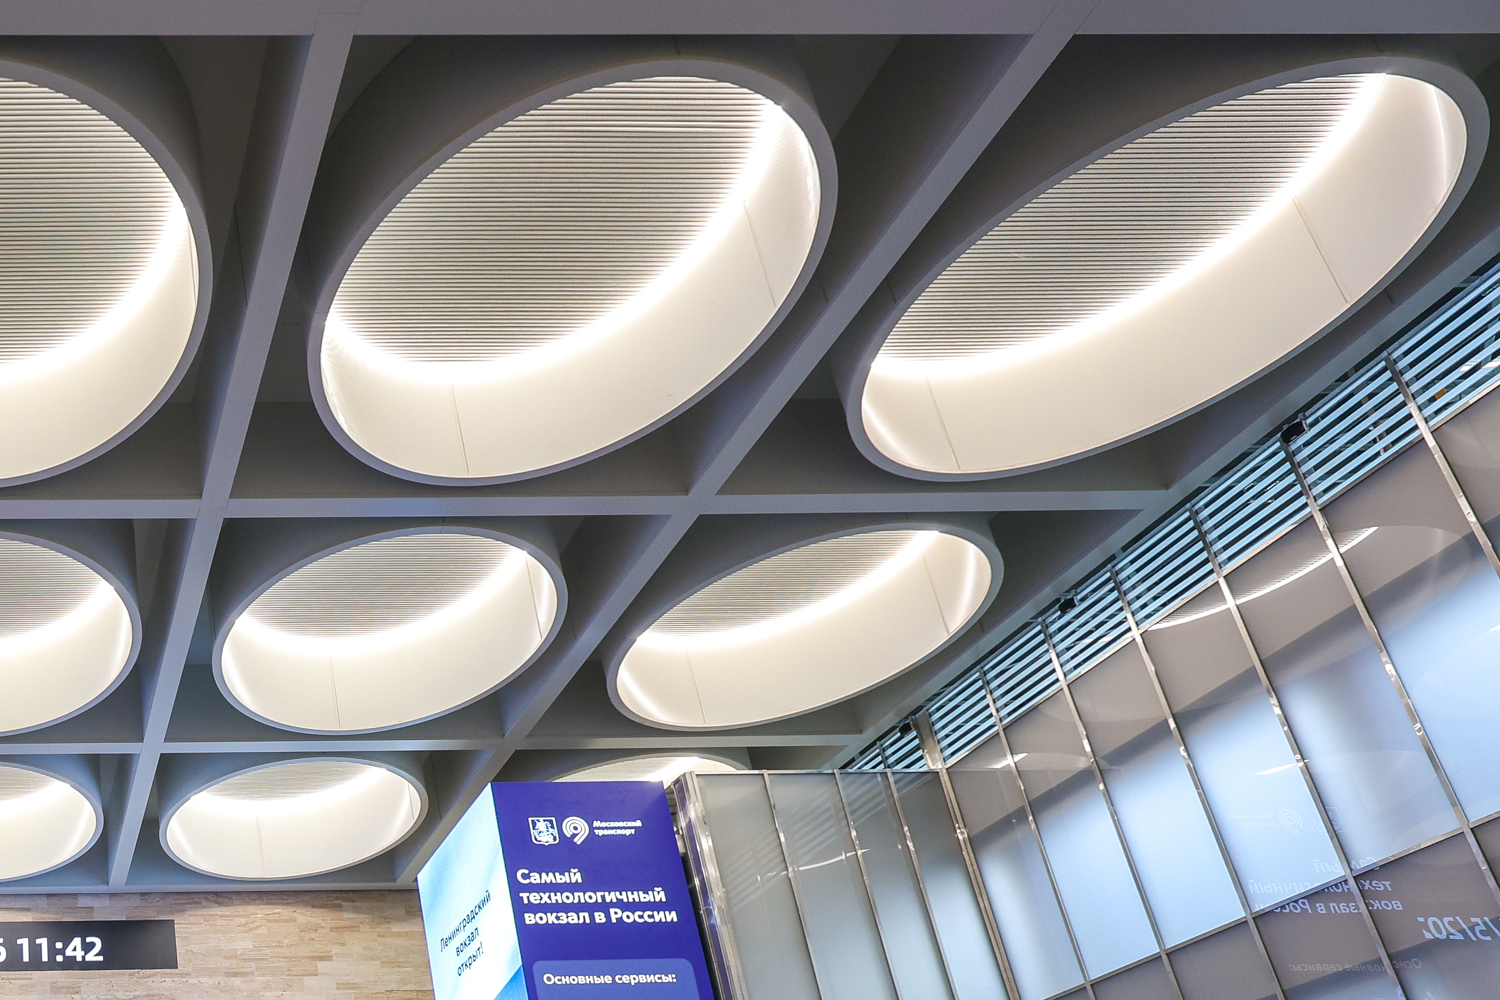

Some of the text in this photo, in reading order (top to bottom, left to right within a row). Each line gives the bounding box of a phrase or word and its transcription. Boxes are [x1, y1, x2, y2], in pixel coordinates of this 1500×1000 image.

[517, 869, 582, 884] Самый
[519, 887, 666, 904] технологичный
[439, 889, 492, 953] Ленинградский
[524, 908, 677, 924] вокзал в России
[17, 937, 103, 962] 11:42
[455, 927, 480, 957] вокзал
[457, 941, 485, 977] открыт!
[543, 974, 676, 985] Основные сервисы:
